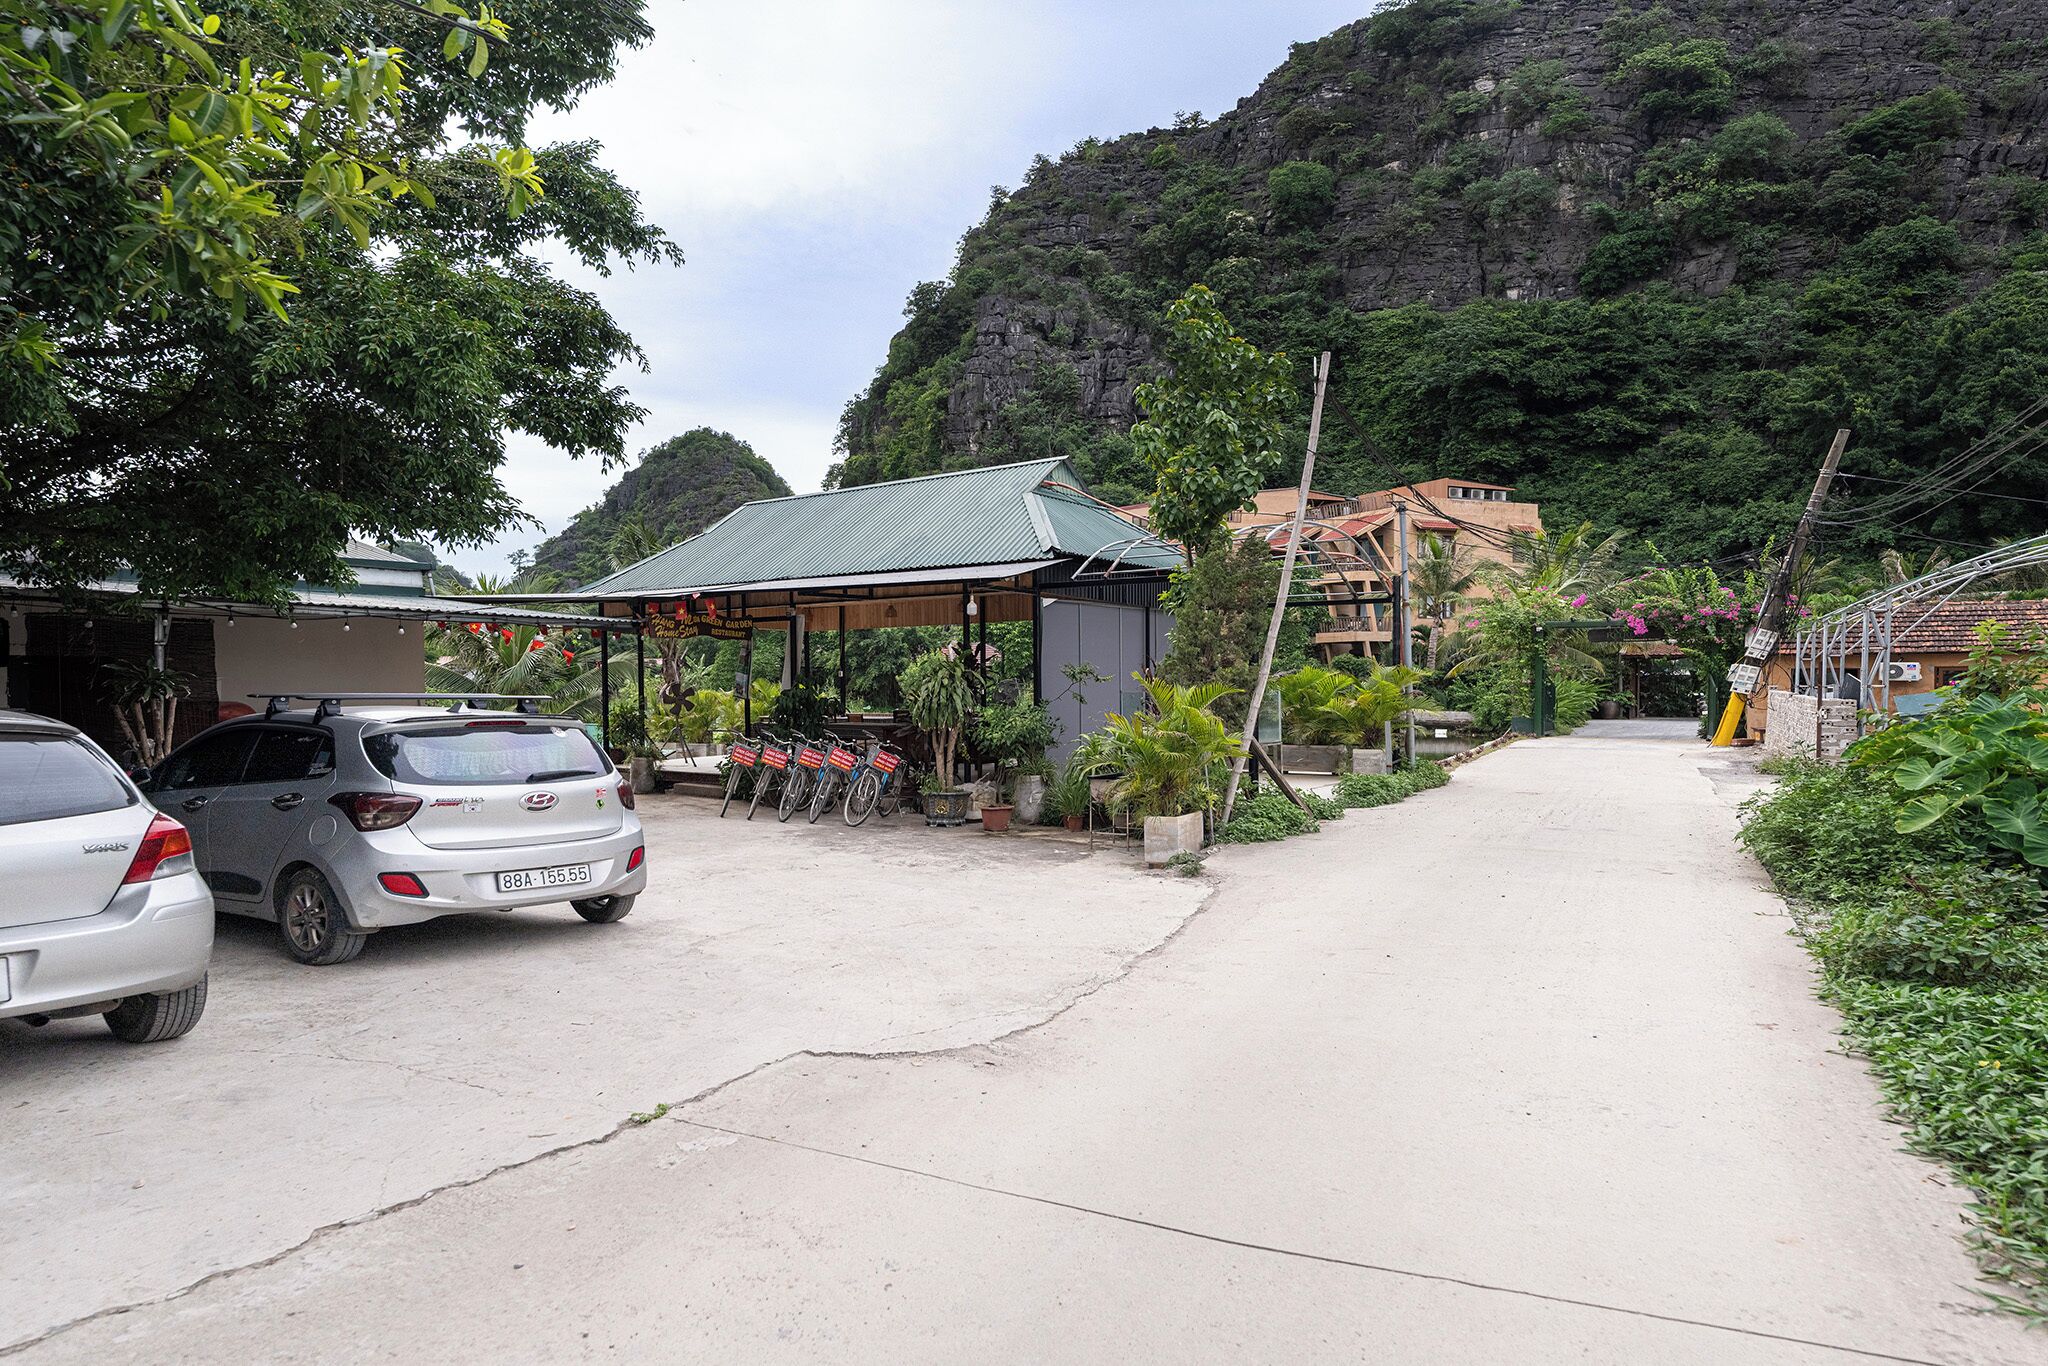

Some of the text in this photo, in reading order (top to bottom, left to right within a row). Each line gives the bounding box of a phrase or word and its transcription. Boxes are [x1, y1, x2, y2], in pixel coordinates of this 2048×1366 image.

[701, 614, 753, 629] GREEN GARDEN
[711, 628, 746, 638] RESTAURANT
[82, 843, 129, 854] YARIS
